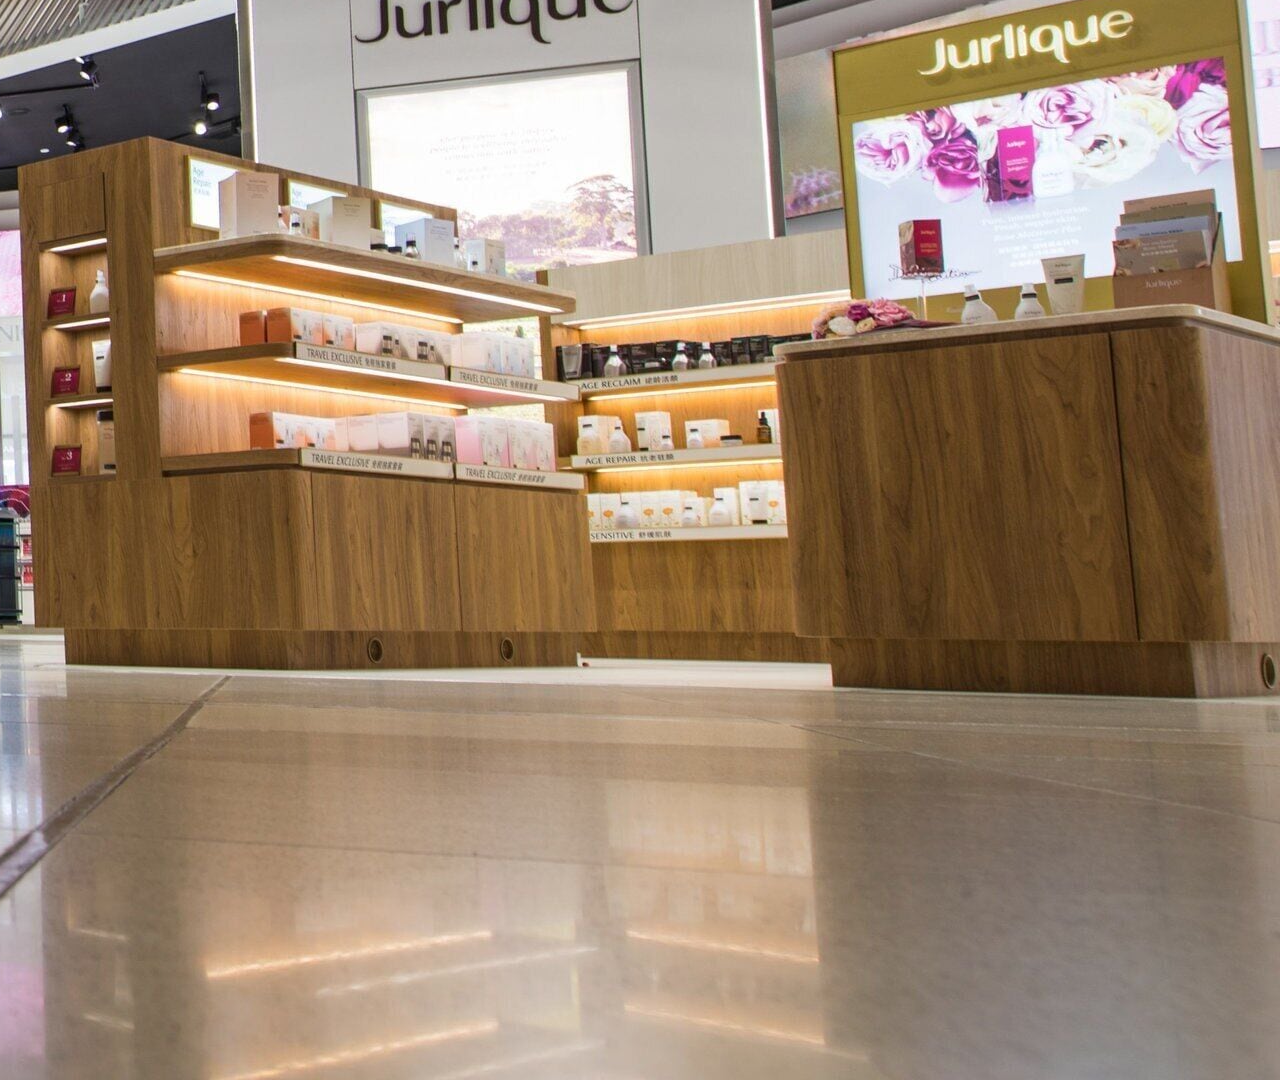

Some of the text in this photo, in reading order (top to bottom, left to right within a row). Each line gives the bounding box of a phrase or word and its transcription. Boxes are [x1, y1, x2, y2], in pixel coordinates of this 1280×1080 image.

[918, 9, 1135, 75] Jurlique
[306, 347, 330, 361] TRAVEL
[331, 350, 363, 366] EXCLUSIVE
[459, 371, 479, 383] TRAVEL
[479, 373, 508, 388] EXCLUSIVE
[581, 382, 599, 390] AGE
[601, 378, 641, 388] RECLAIM
[311, 453, 335, 465] TRAVEL
[336, 455, 370, 469] EXCLUSIVE
[585, 457, 603, 465] AGE
[605, 455, 637, 464] REPAIR
[465, 467, 488, 478] TRAVEL
[488, 469, 517, 481] EXCLUSIVE
[590, 532, 634, 540] SENSITIVE
